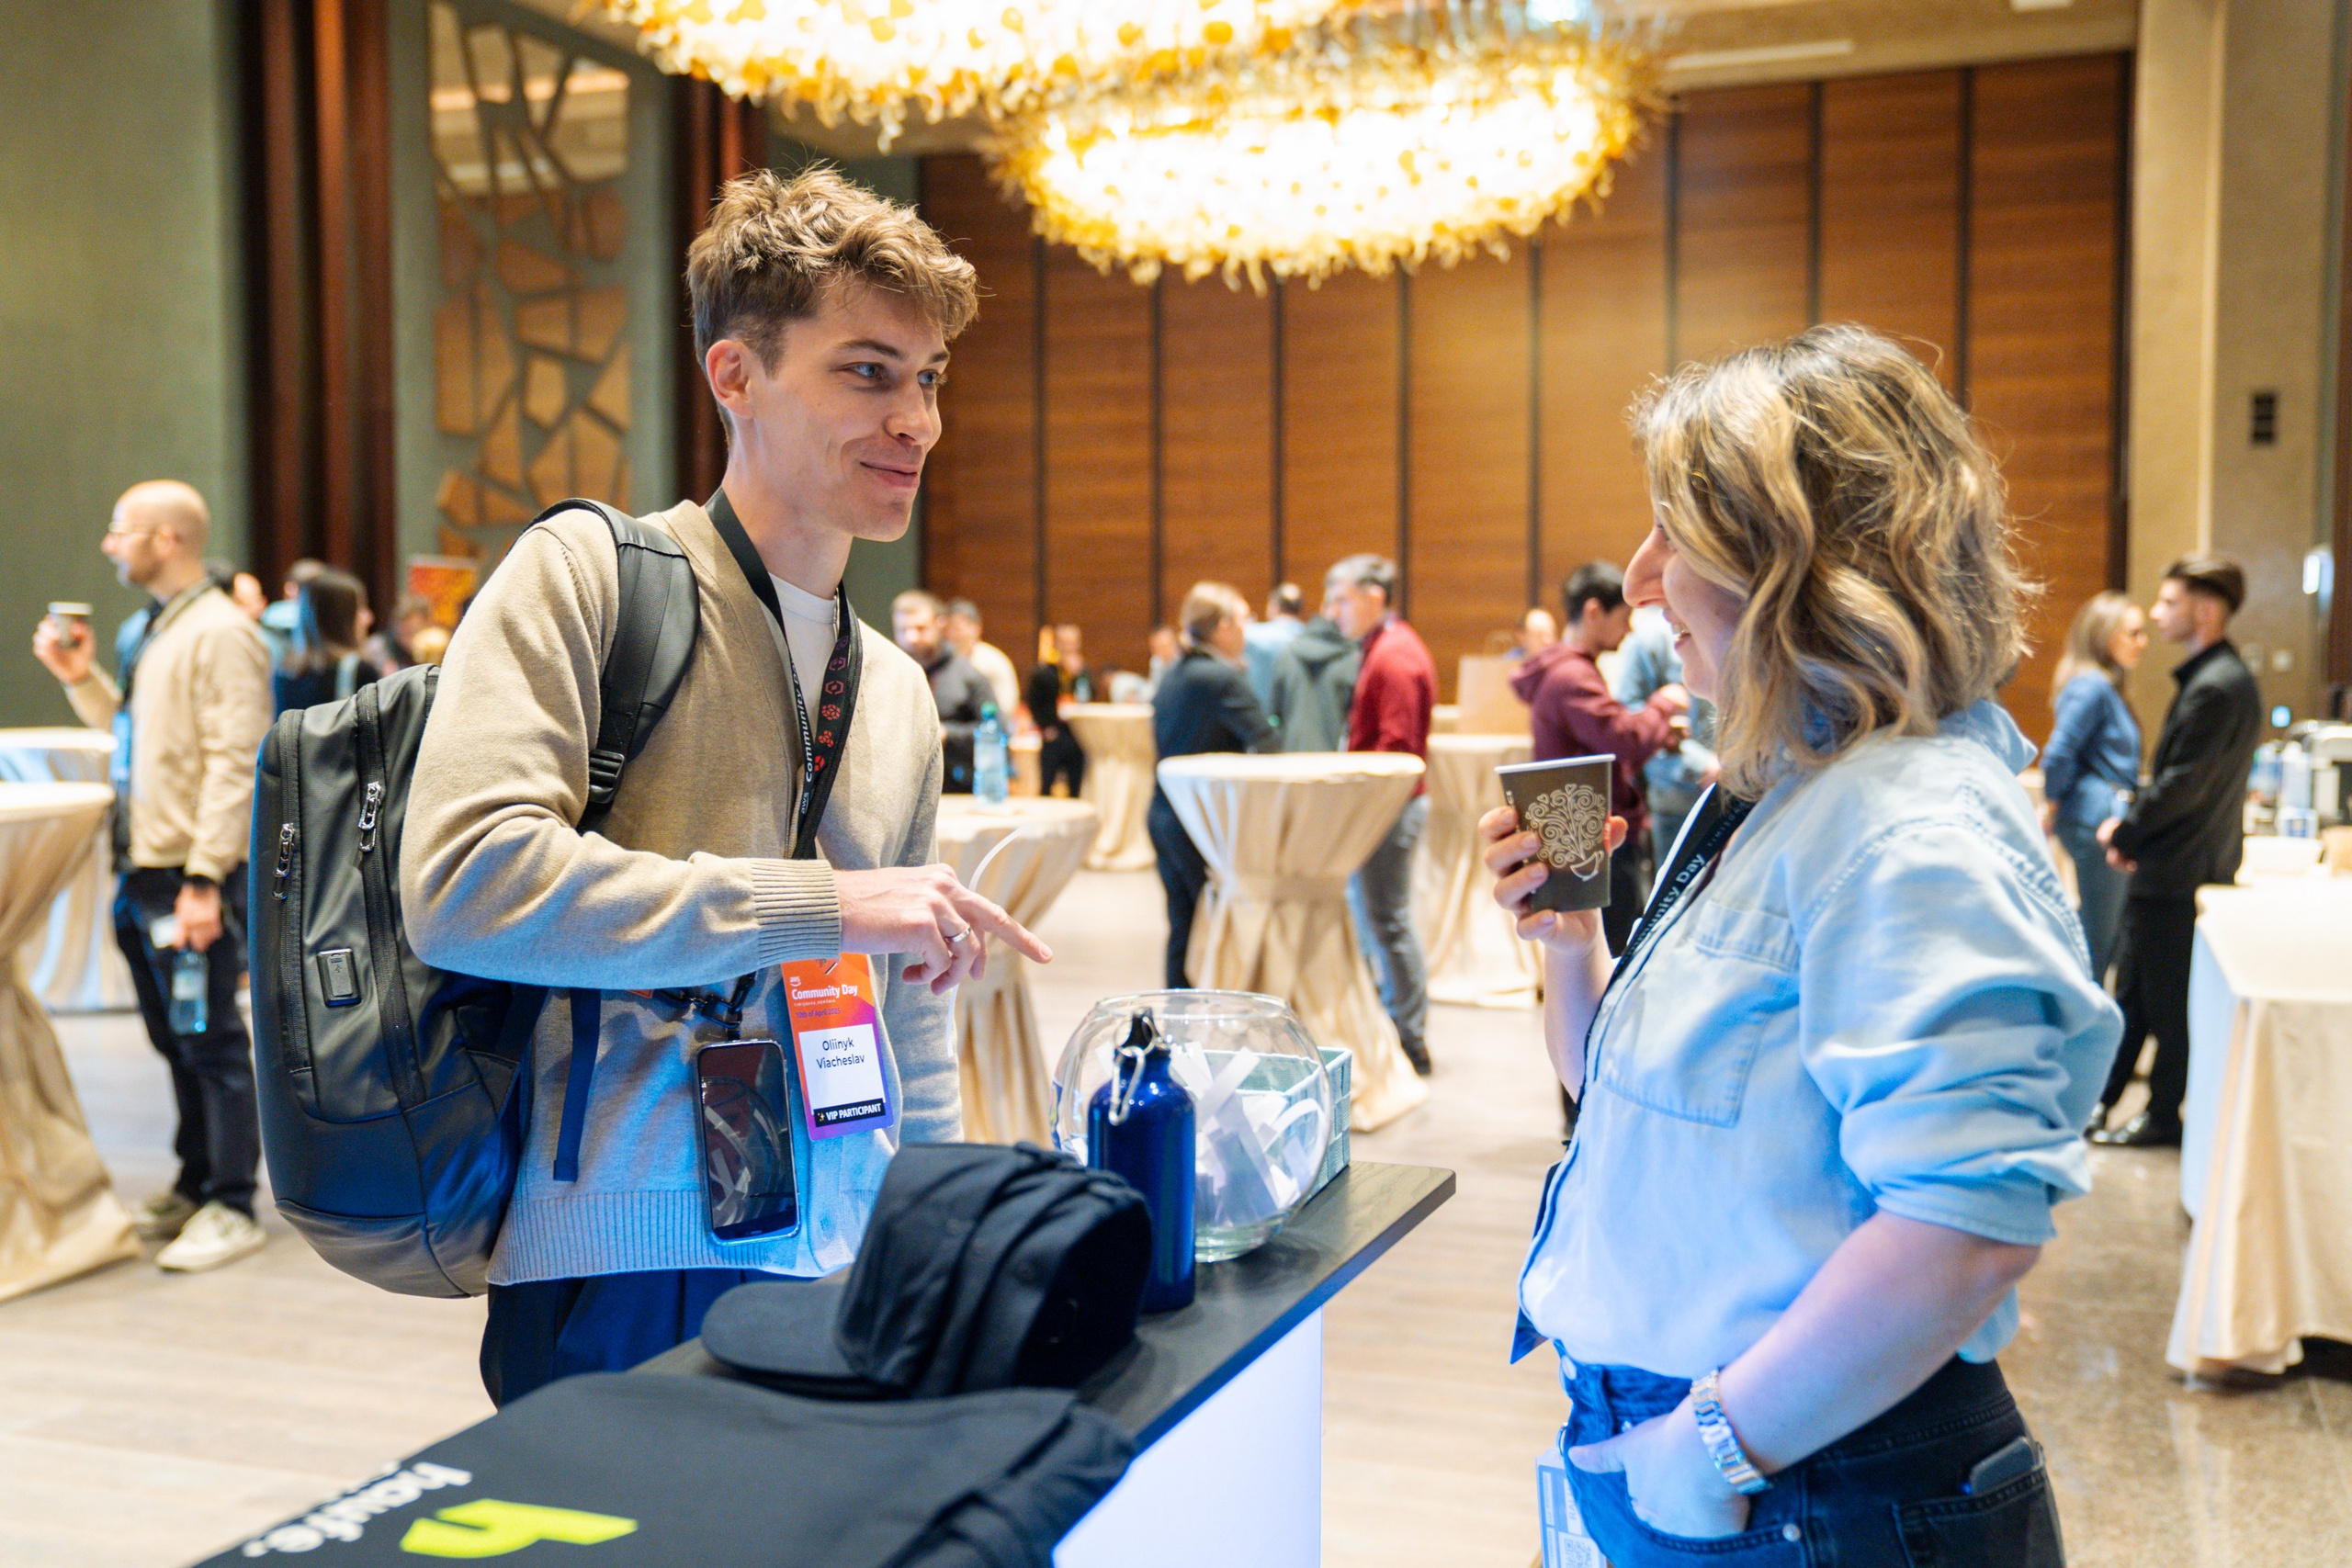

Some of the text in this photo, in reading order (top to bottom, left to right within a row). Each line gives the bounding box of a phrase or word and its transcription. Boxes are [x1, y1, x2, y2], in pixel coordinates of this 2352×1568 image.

[796, 692, 813, 783] Community
[1675, 853, 1706, 884] Day
[791, 984, 858, 1000] Community Day
[822, 1037, 854, 1052] Oliinyk
[816, 1054, 865, 1069] Viacheslav
[826, 1103, 881, 1121] VIP PARTICIPANT
